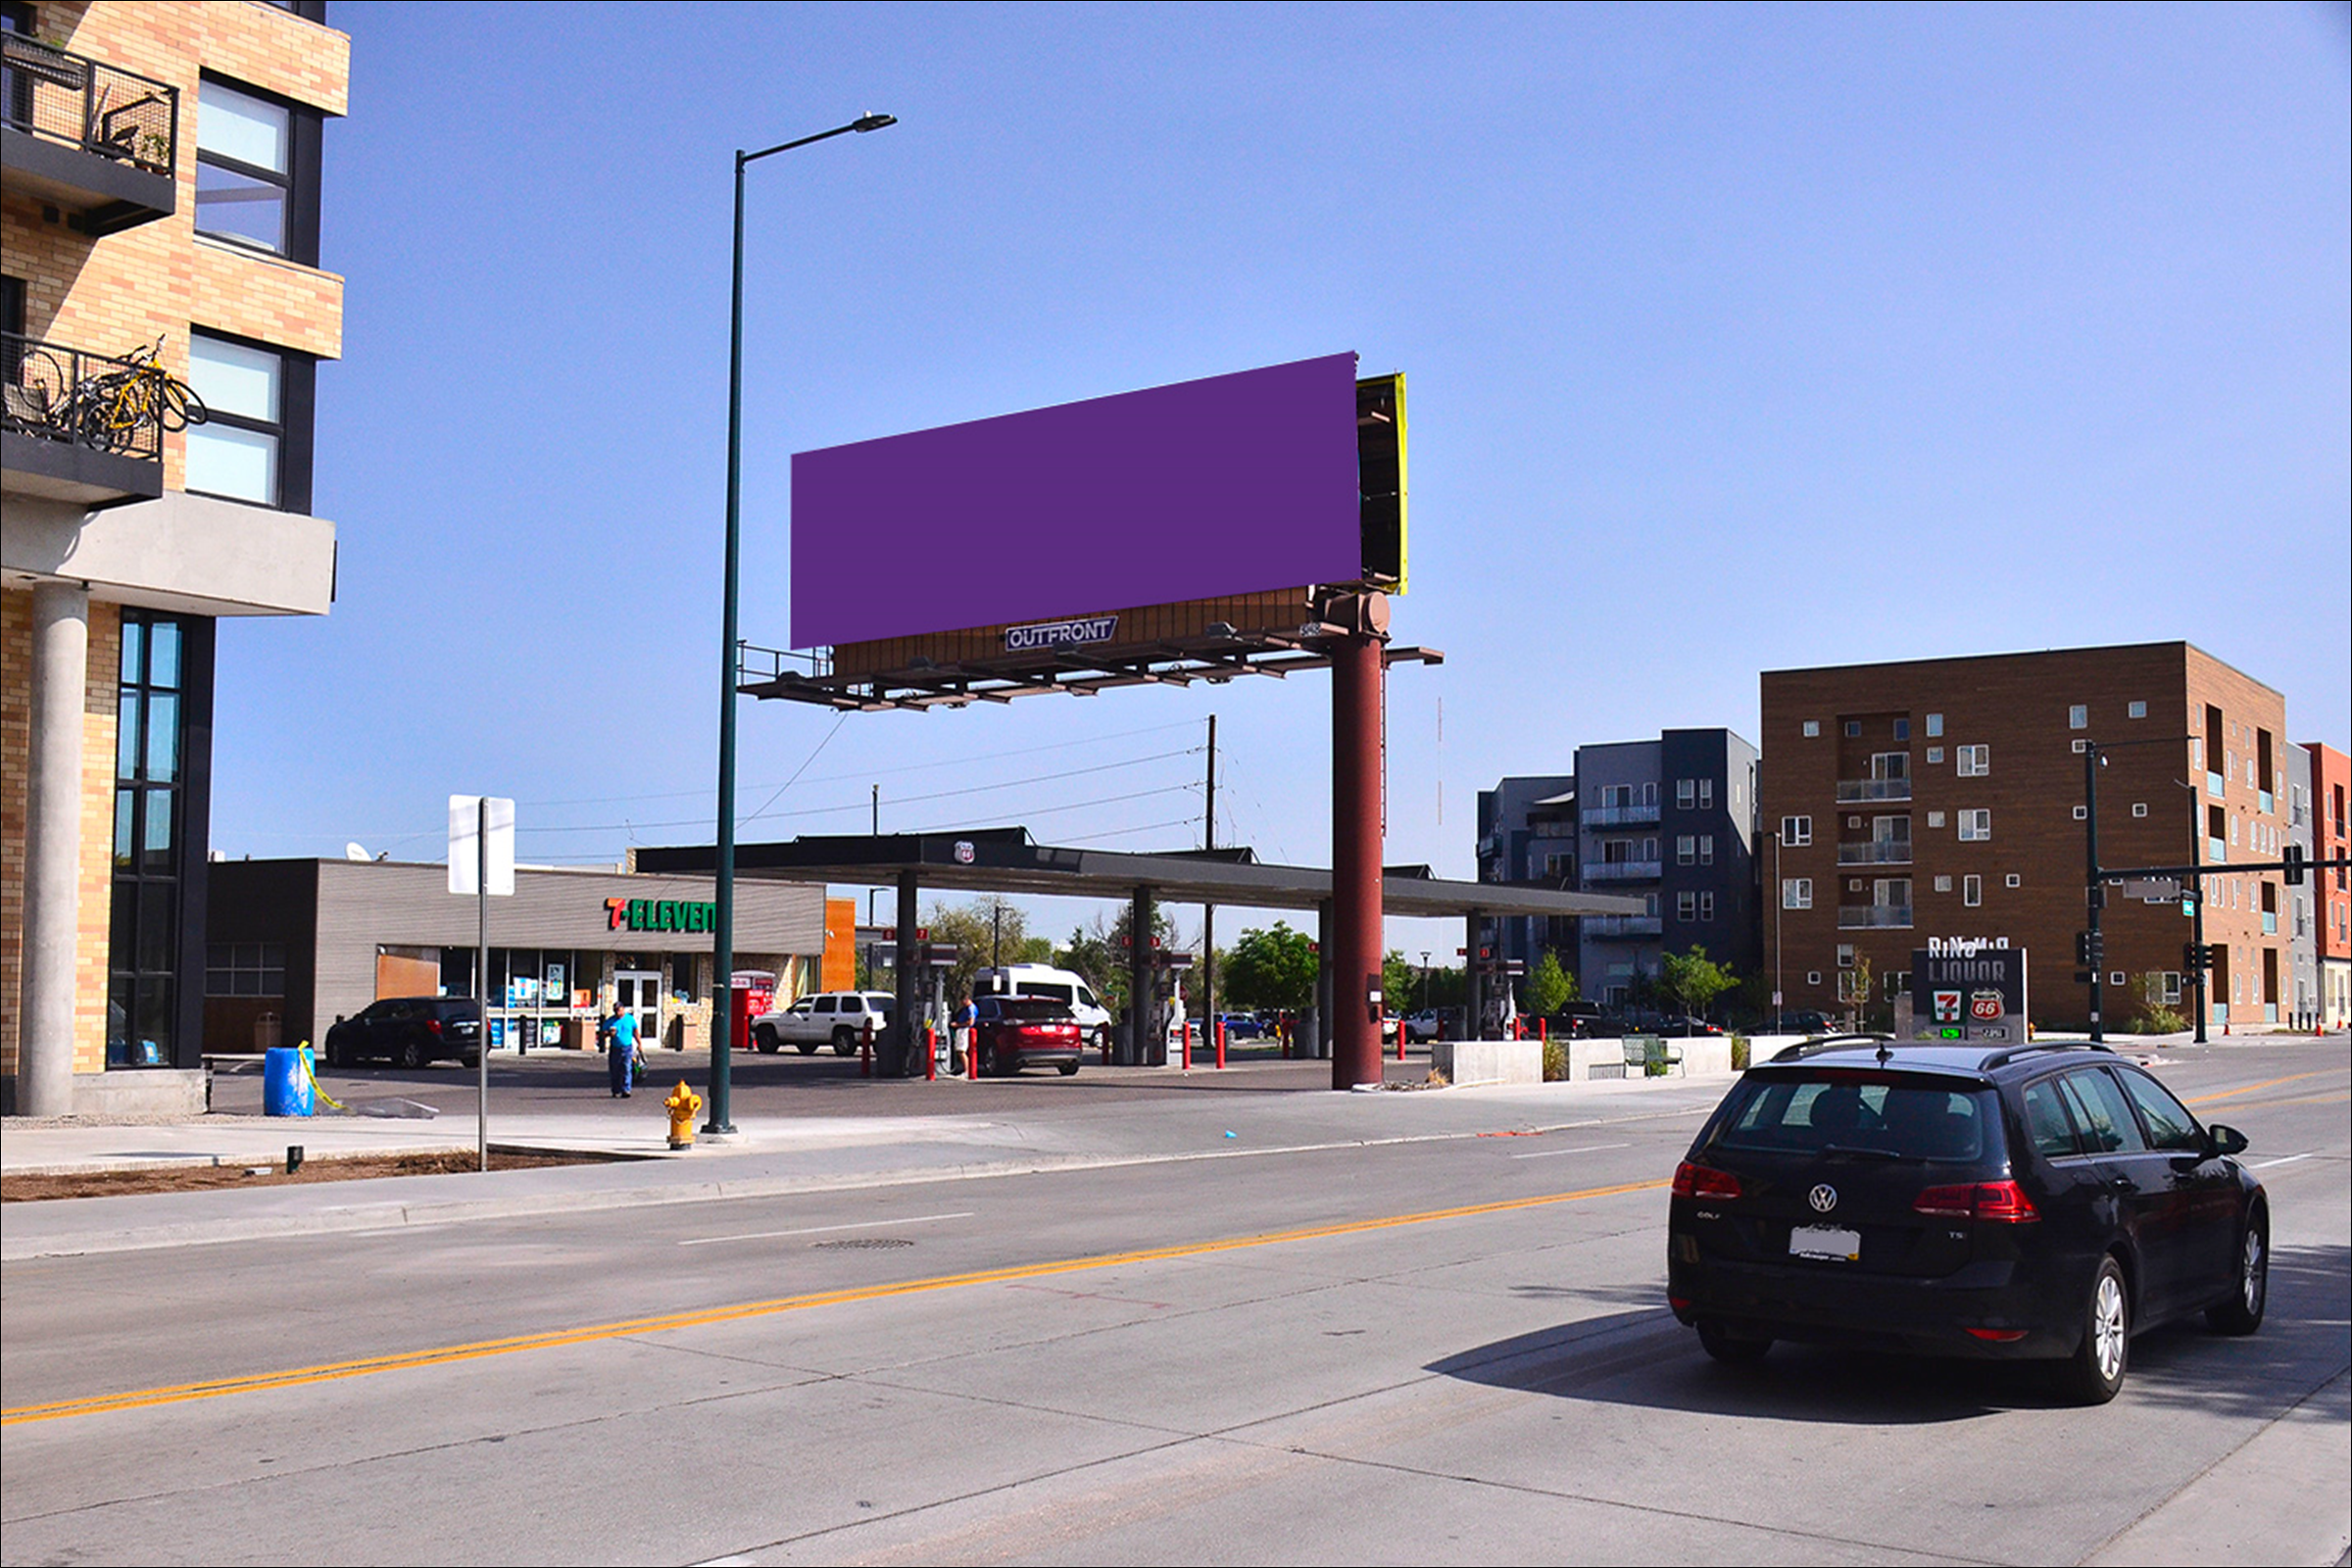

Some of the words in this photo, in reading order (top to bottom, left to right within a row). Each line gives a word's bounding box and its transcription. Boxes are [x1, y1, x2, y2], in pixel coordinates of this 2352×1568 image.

[1009, 620, 1110, 647] OUTFRONT
[1929, 960, 2005, 983] LIQUOR
[1975, 1002, 1996, 1014] 66
